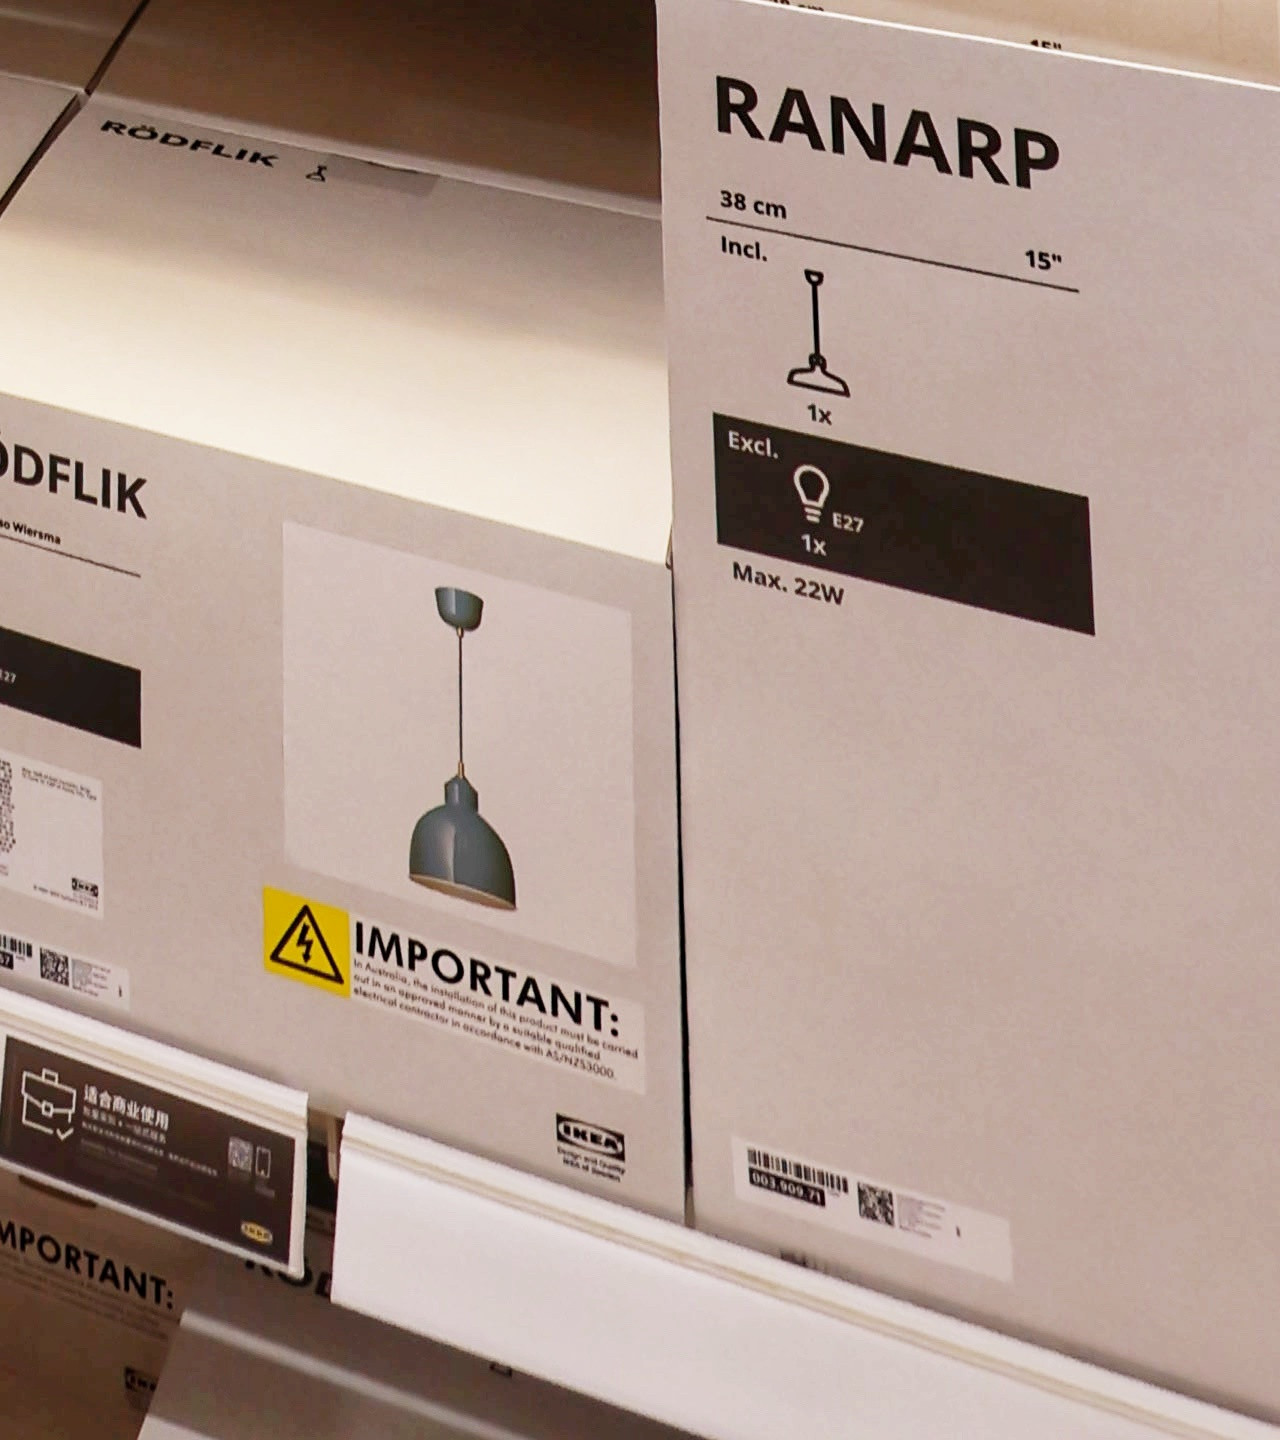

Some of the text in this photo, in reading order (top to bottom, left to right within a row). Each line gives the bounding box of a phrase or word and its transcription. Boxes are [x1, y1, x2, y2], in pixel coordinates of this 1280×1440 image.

[99, 118, 280, 170] RÖDFLIK
[714, 74, 1061, 190] RANARP
[719, 188, 788, 220] 38 cm
[719, 234, 769, 264] Incl.
[1024, 248, 1063, 272] 15"
[806, 402, 833, 426] 1x
[727, 430, 780, 460] Excl.
[12, 519, 62, 546] Wiersma
[832, 512, 865, 532] E27
[800, 532, 828, 557] 1x
[732, 561, 845, 605] Max. 22W
[355, 921, 620, 1038] IMPORTANT:
[353, 987, 398, 1008] electrical
[399, 1001, 450, 1026] contractor
[462, 1021, 522, 1049] accordance
[398, 986, 446, 1010] approved
[447, 1002, 487, 1024] manner
[519, 1012, 559, 1033] product
[602, 1040, 639, 1060] carried
[83, 1083, 170, 1132] 适合商业使用
[751, 1170, 823, 1207] 003.909.71
